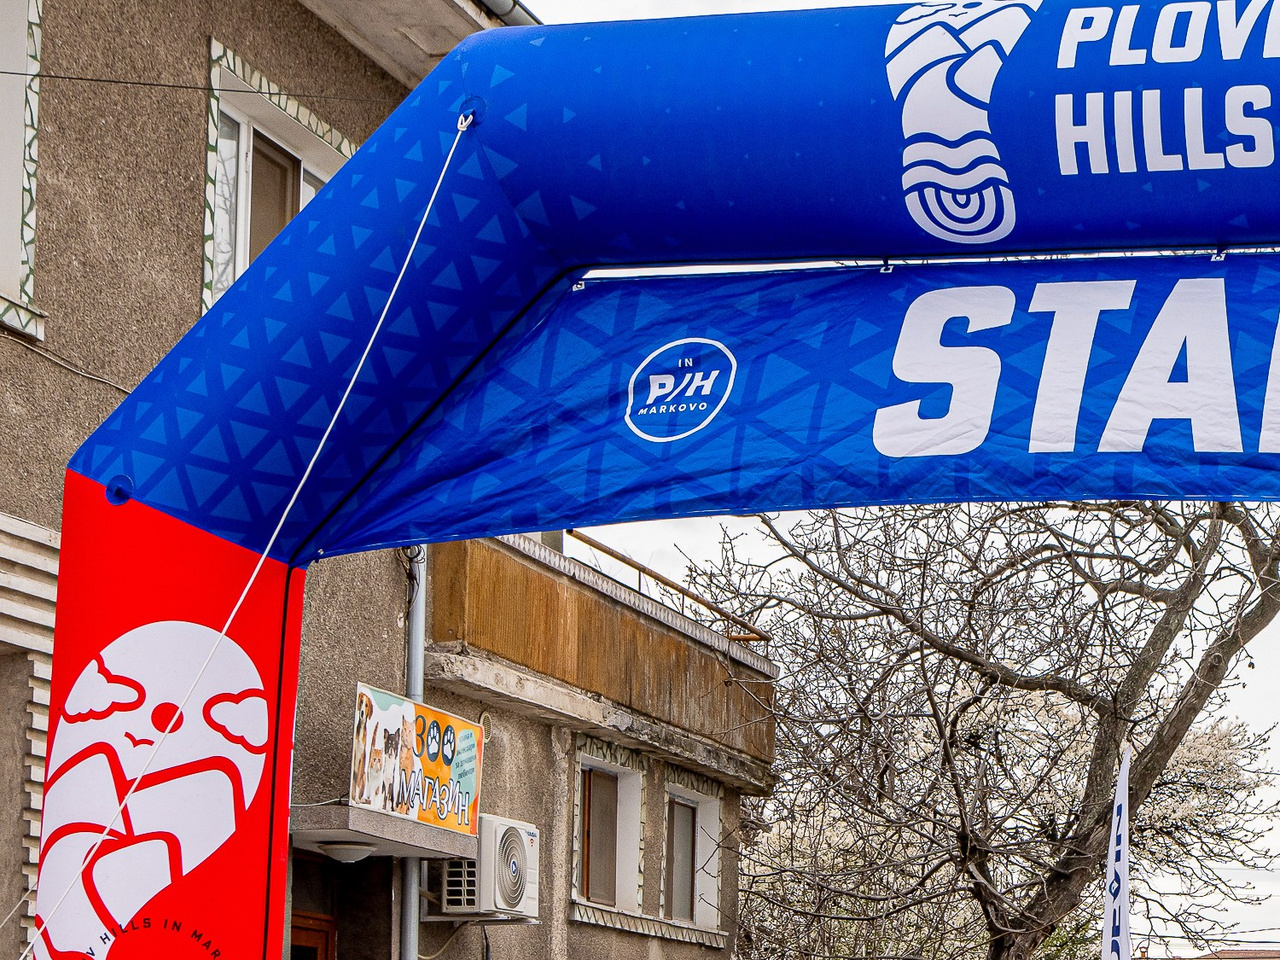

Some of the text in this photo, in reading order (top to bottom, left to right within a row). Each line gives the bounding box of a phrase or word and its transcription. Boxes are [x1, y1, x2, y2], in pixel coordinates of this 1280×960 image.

[1055, 85, 1275, 175] HILLS
[678, 358, 693, 367] IN
[646, 370, 720, 405] P/H
[638, 402, 708, 415] MARKOVO
[399, 768, 470, 825] МАГАЗИН
[99, 918, 151, 944] HILLS
[164, 918, 182, 932] IN
